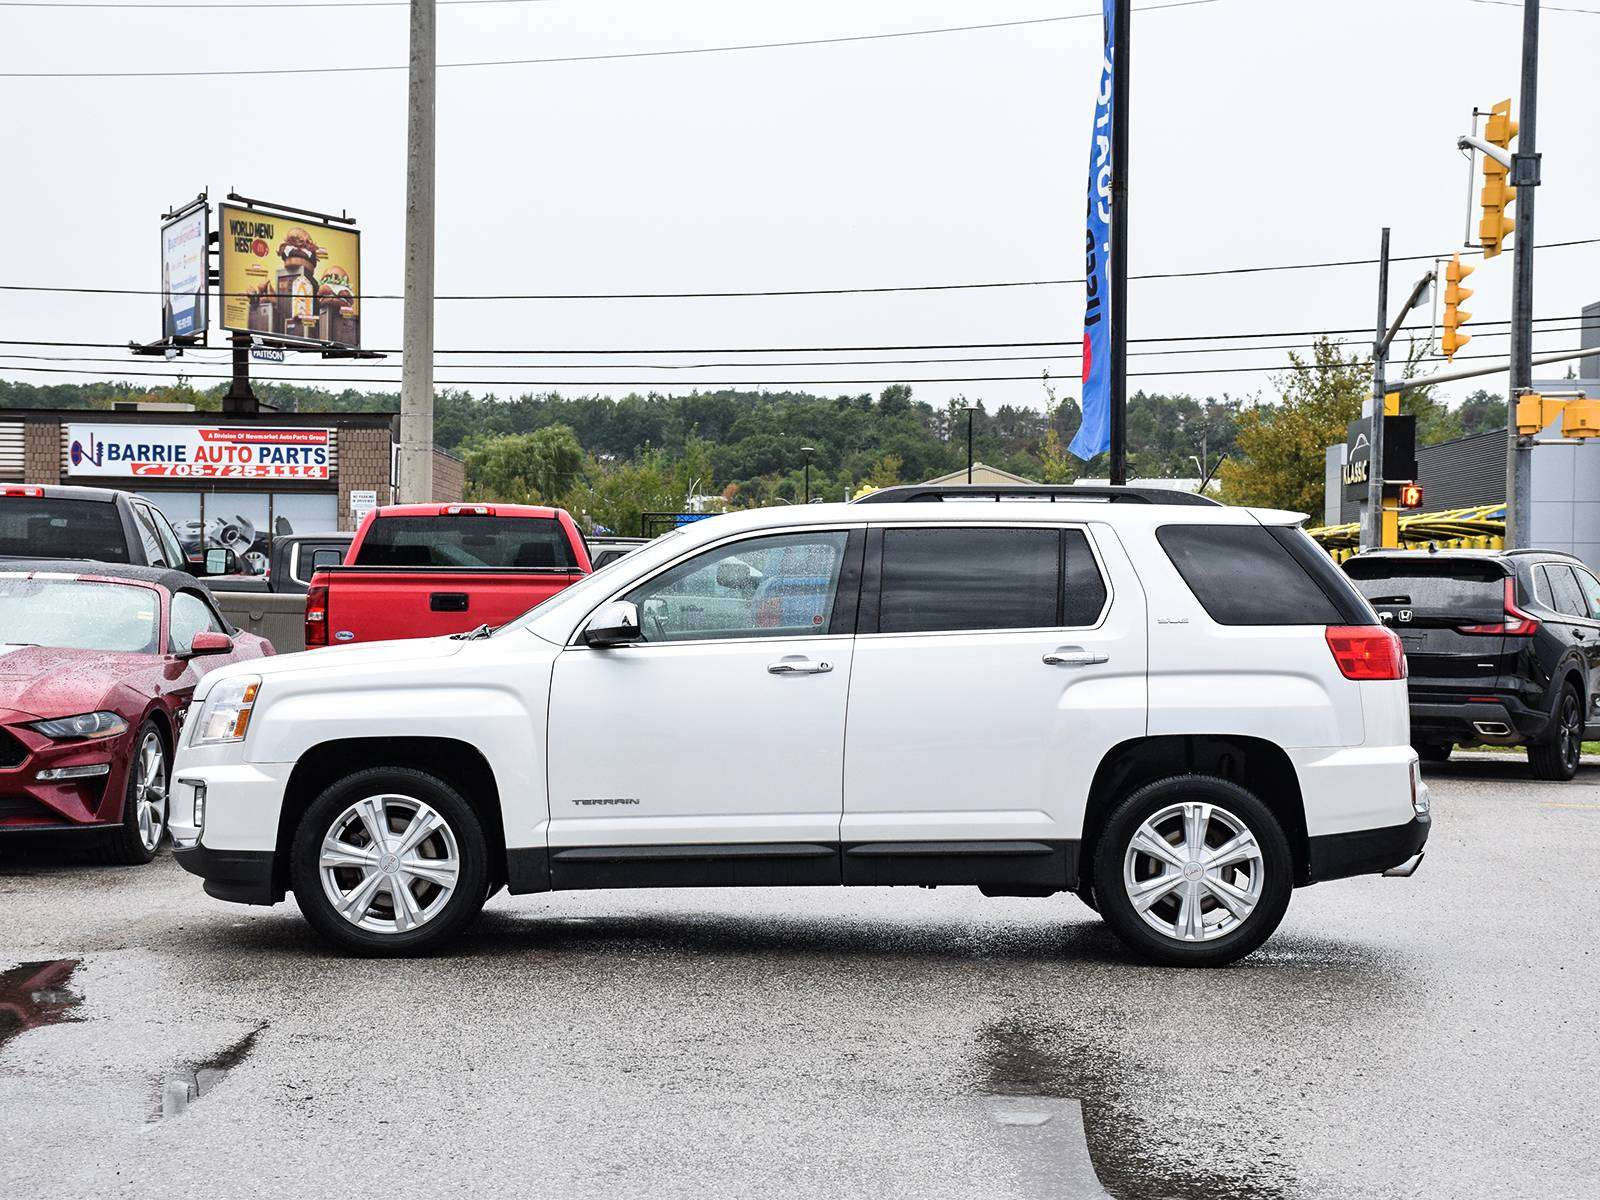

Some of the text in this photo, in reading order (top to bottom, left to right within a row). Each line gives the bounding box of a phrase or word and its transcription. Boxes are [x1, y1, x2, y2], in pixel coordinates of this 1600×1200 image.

[229, 219, 274, 239] WORLD MENU
[107, 443, 326, 465] BARRIE AUTO PARTS
[163, 463, 320, 478] 705-725-1114
[572, 798, 641, 806] TERRAIN
